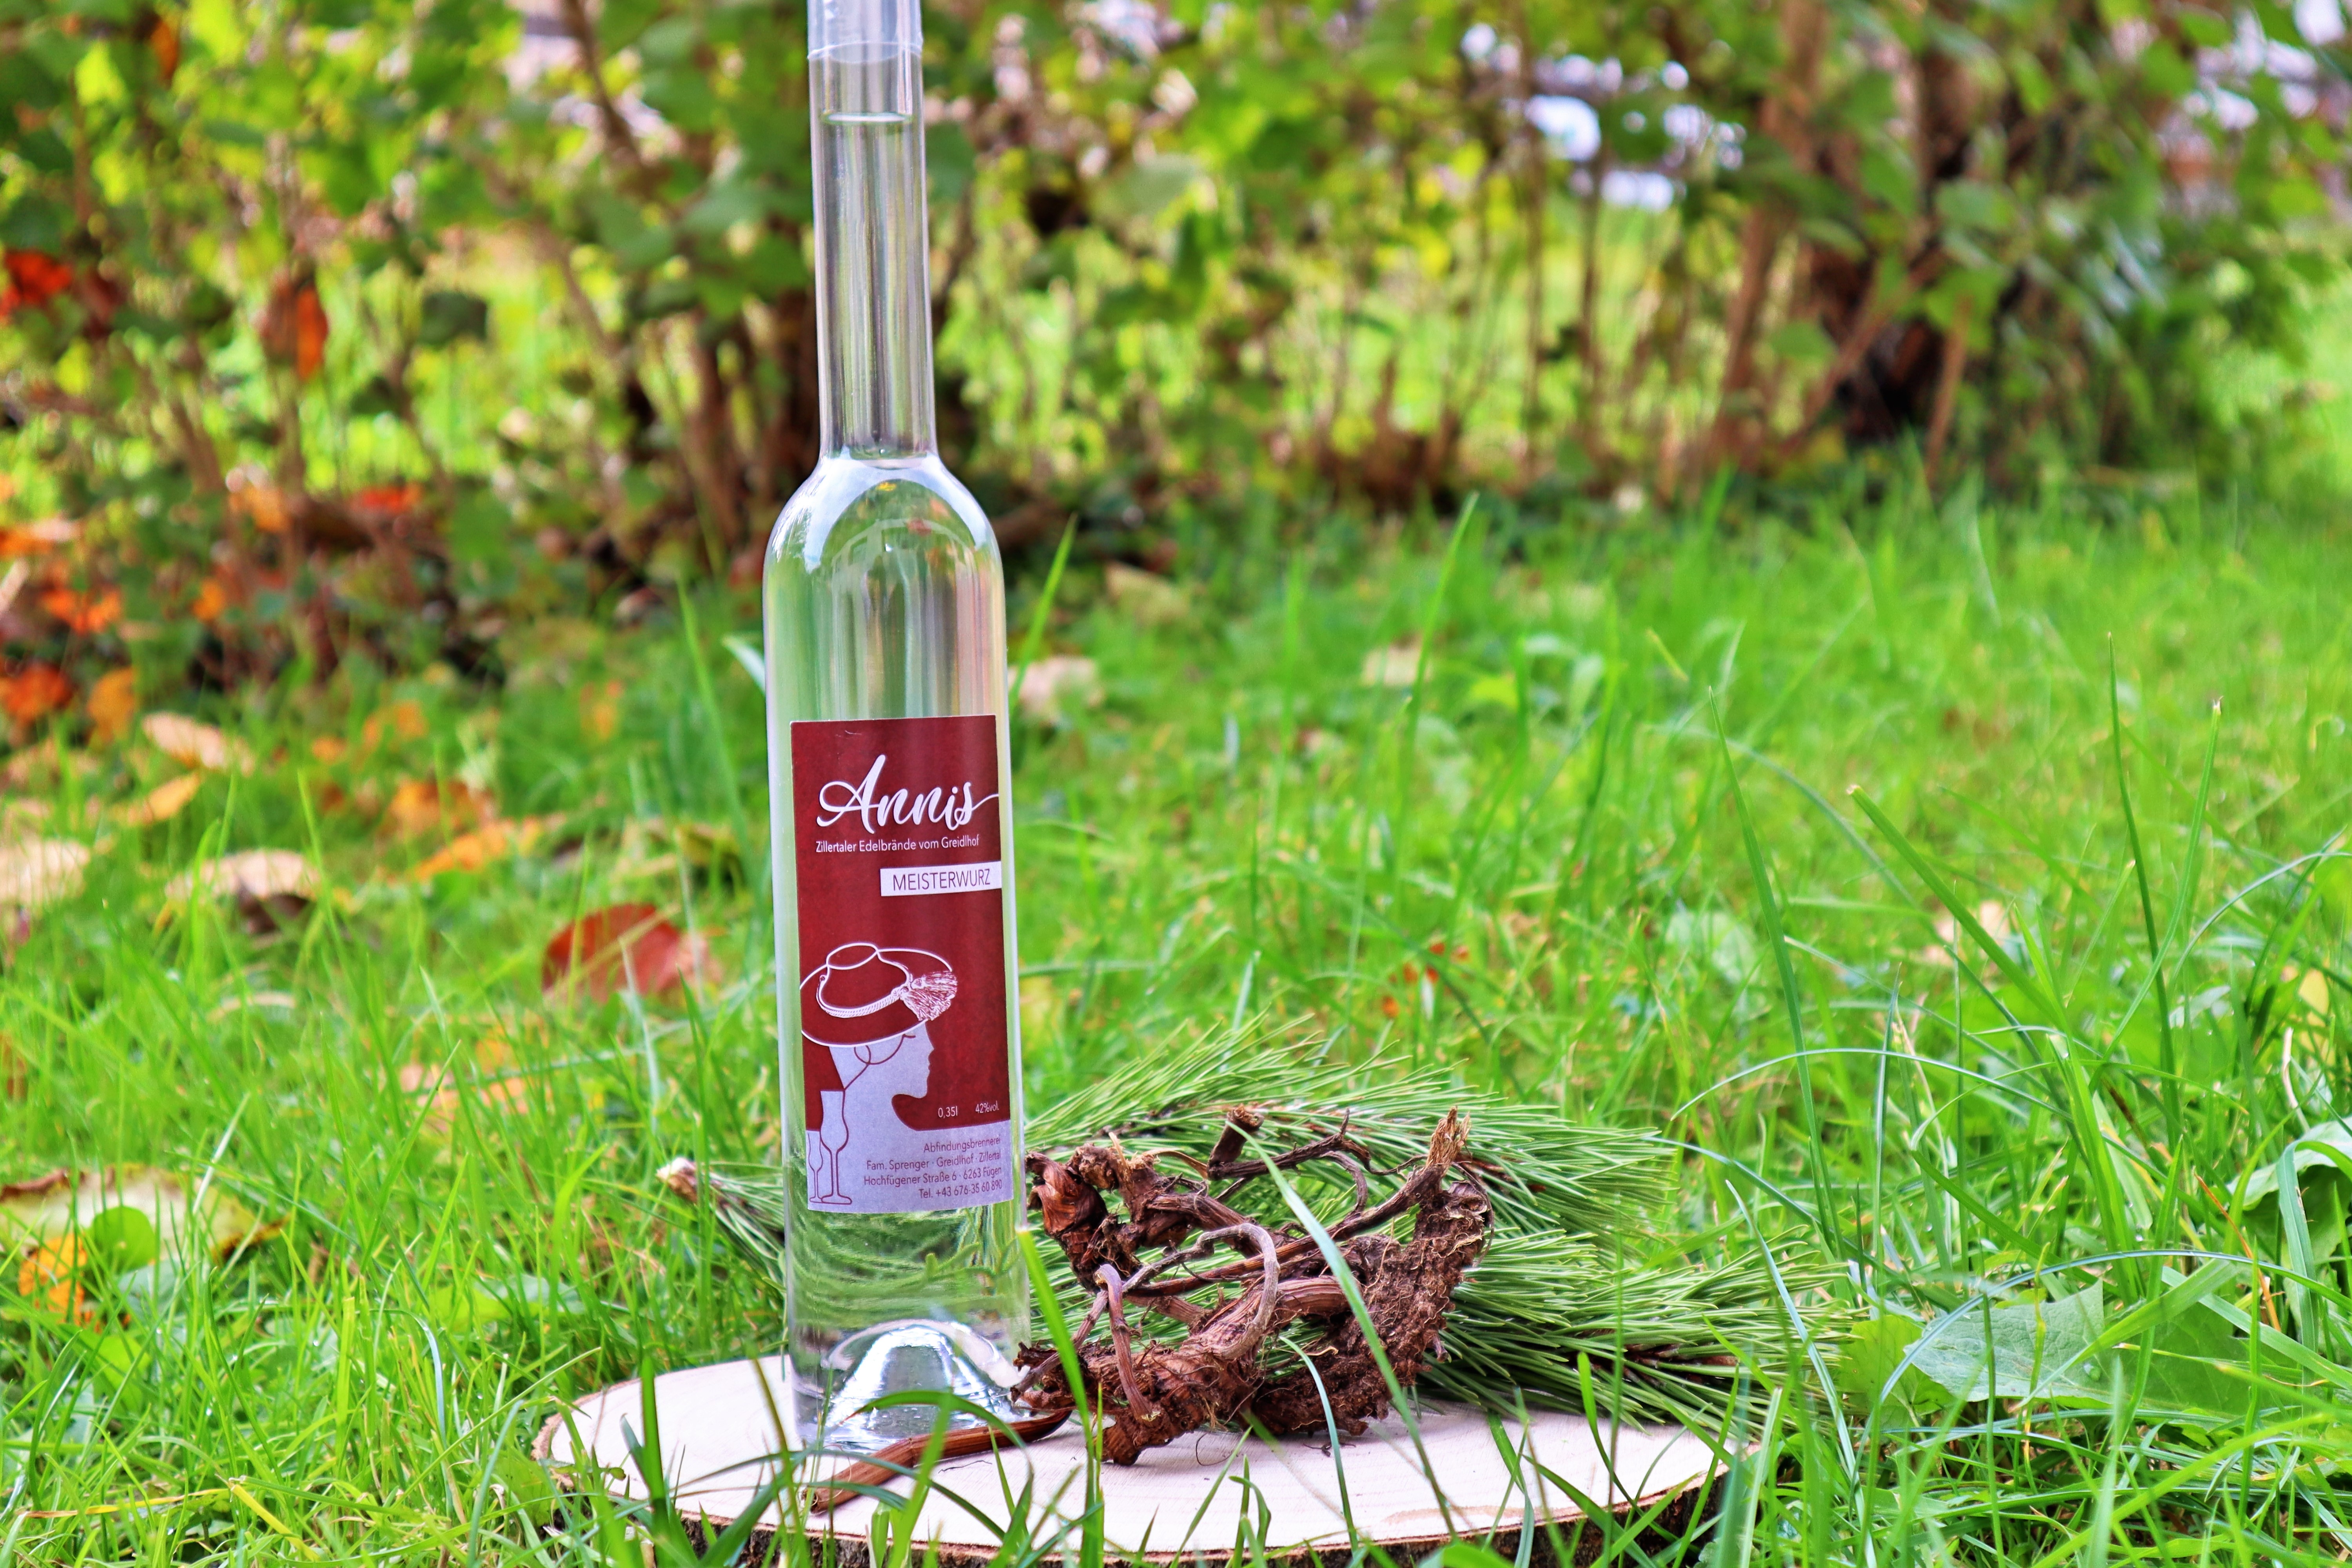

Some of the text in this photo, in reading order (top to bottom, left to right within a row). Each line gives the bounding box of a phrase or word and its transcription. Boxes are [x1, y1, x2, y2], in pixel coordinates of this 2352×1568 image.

[817, 754, 999, 834] Annis
[816, 835, 979, 853] Zillertaler Edelbrände vom Greidlhof
[893, 868, 990, 891] MEISTERWURZ
[924, 1137, 1001, 1153] Abfindungsbrennerei
[867, 1150, 1001, 1172] Fam. Sprenger Greidlhof Zillertal
[864, 1167, 1002, 1187] Hochfügener Straße 6 6263 Fügen
[918, 1179, 1002, 1199] Tel. +43 676-35 60 890
